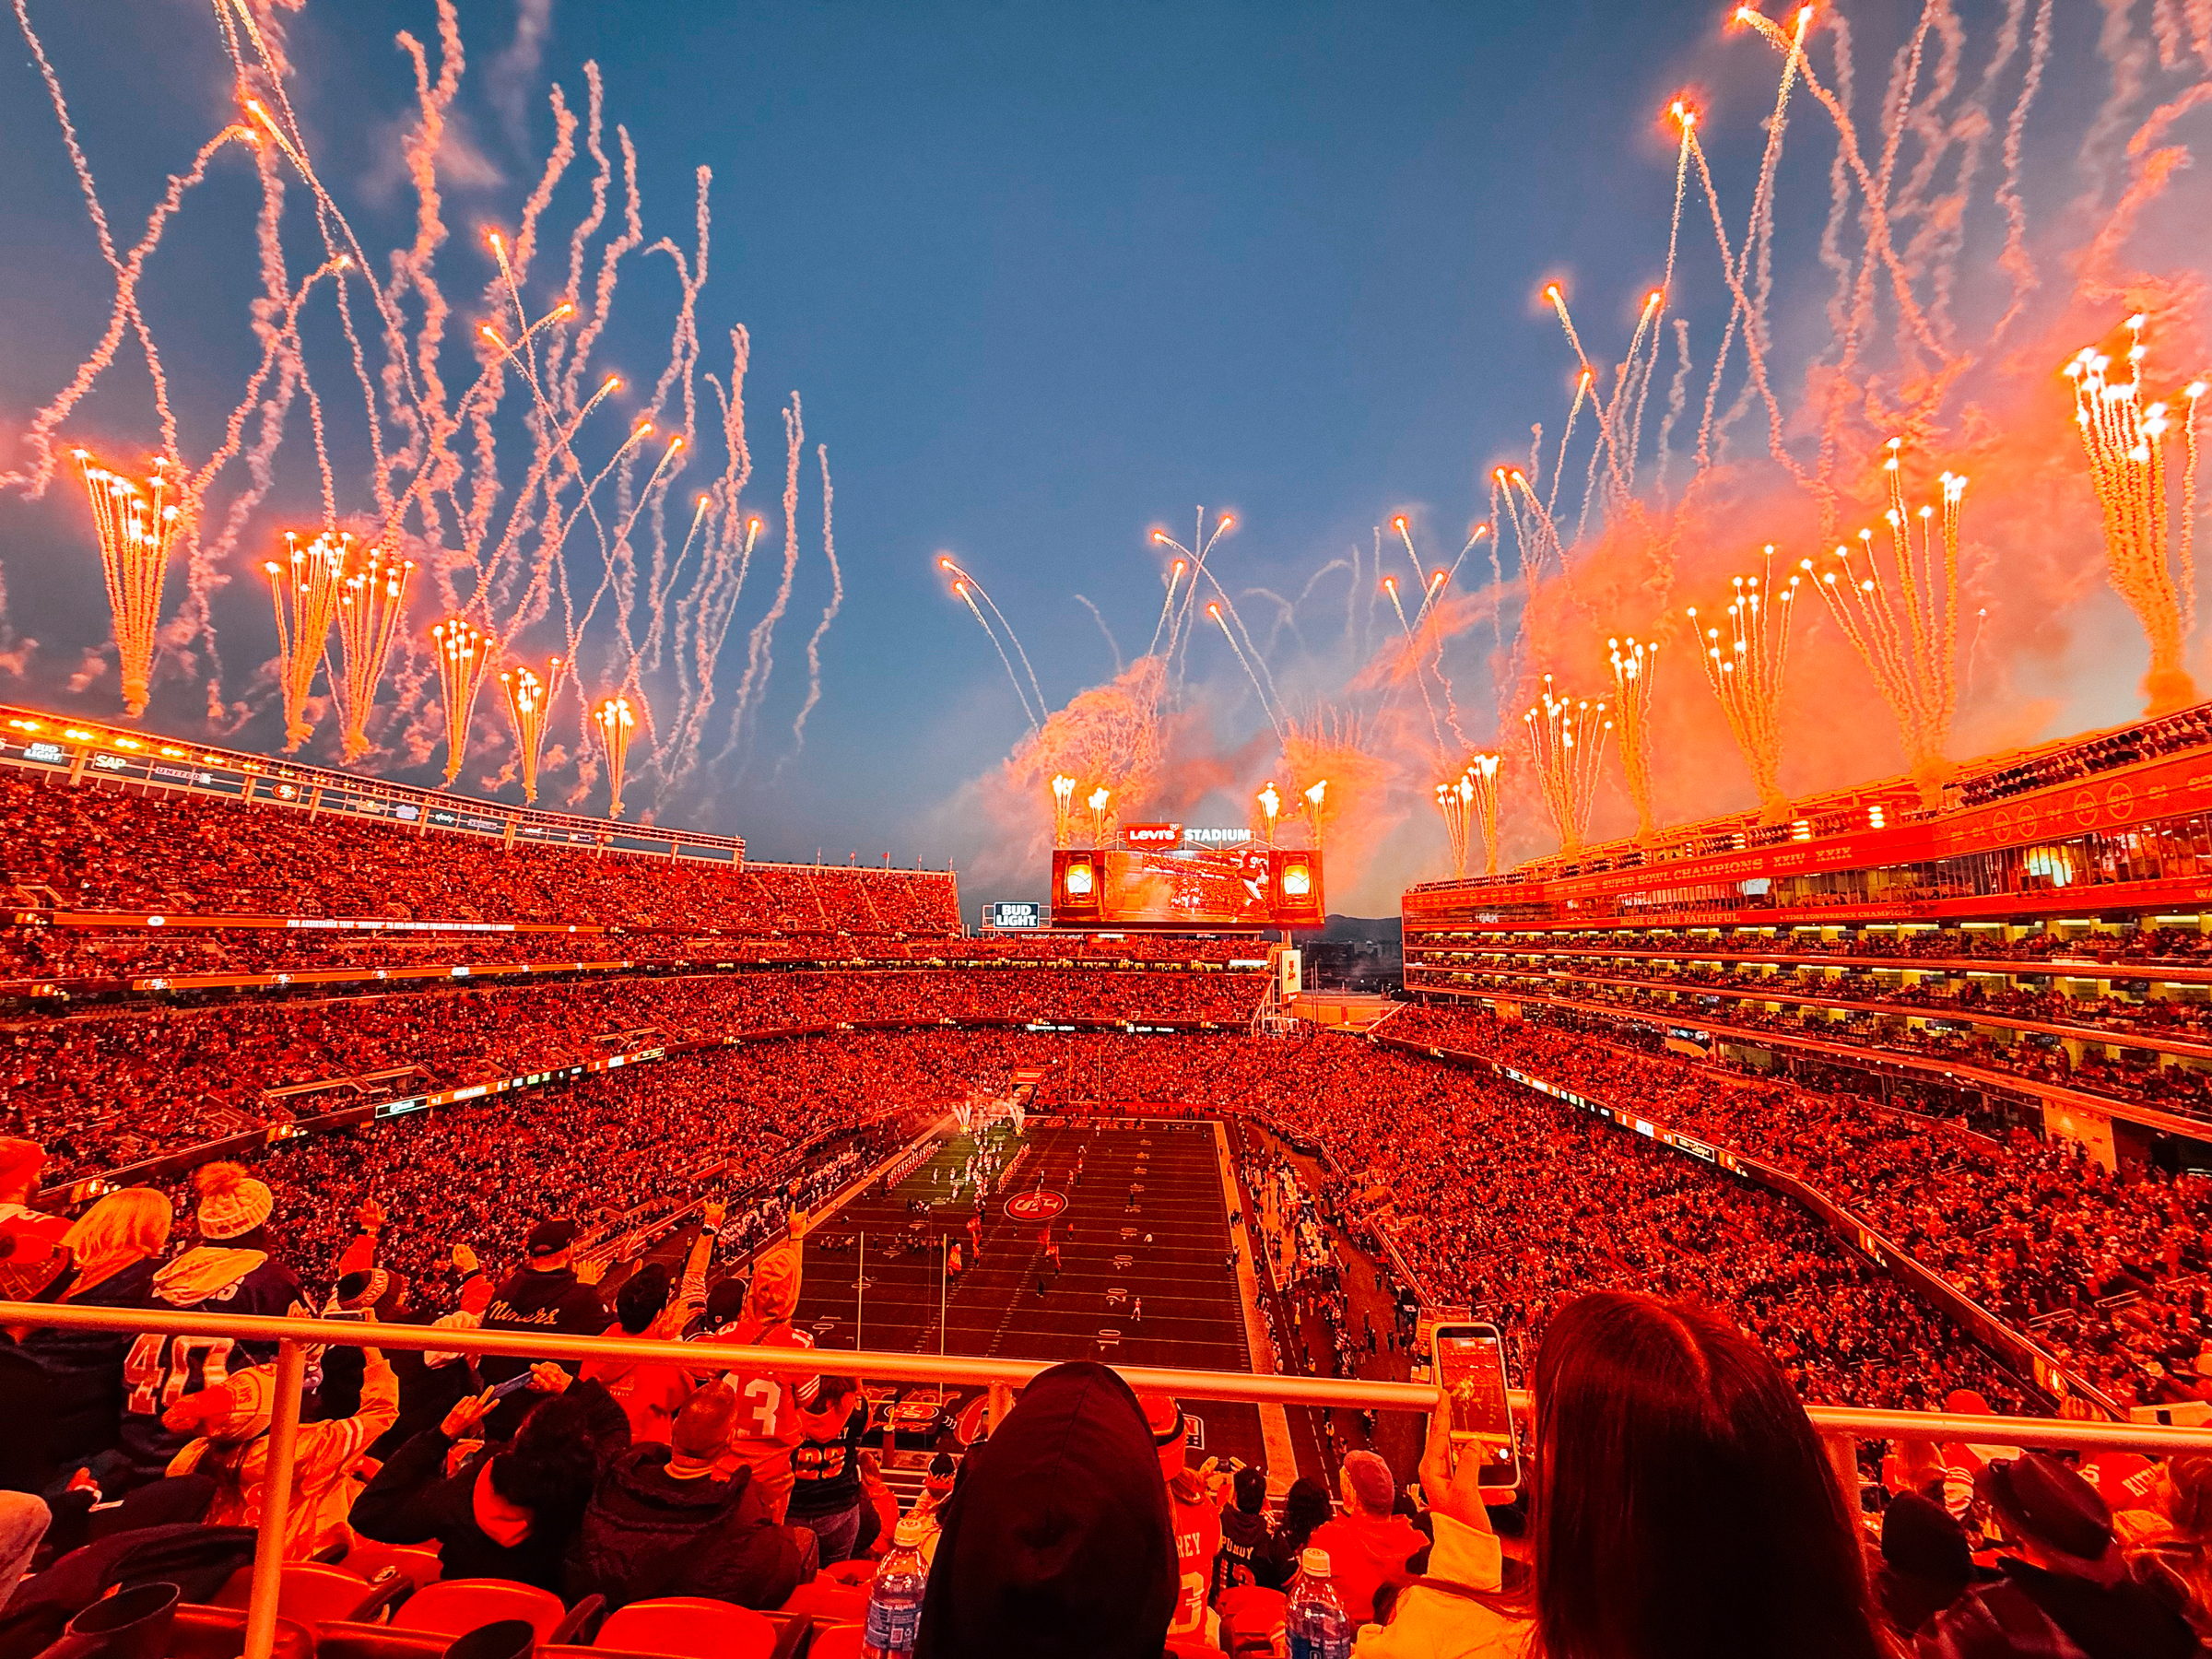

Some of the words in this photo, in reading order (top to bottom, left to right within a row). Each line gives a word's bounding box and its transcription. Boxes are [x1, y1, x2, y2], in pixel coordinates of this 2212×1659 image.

[31, 742, 59, 754] BUD
[24, 749, 62, 762] LIGHT
[96, 755, 126, 770] SAP
[157, 767, 200, 780] UNITED
[1183, 829, 1251, 841] STADIUM
[1601, 877, 1636, 889] SUPER
[1638, 872, 1672, 884] BOWL
[1673, 858, 1764, 880] CHAMPIONS
[1001, 904, 1031, 915] BUD
[1806, 912, 1857, 920] CONFERENCE
[995, 914, 1037, 926] LIGHT
[1620, 917, 1645, 925] HOME
[1646, 916, 1659, 924] OF
[1661, 915, 1681, 924] THE
[1684, 912, 1741, 924] FAITHFUL
[1106, 1288, 1128, 1302] 20
[489, 1300, 560, 1325] Niners
[1096, 1329, 1122, 1346] 10
[1219, 1534, 1254, 1560] PURDY
